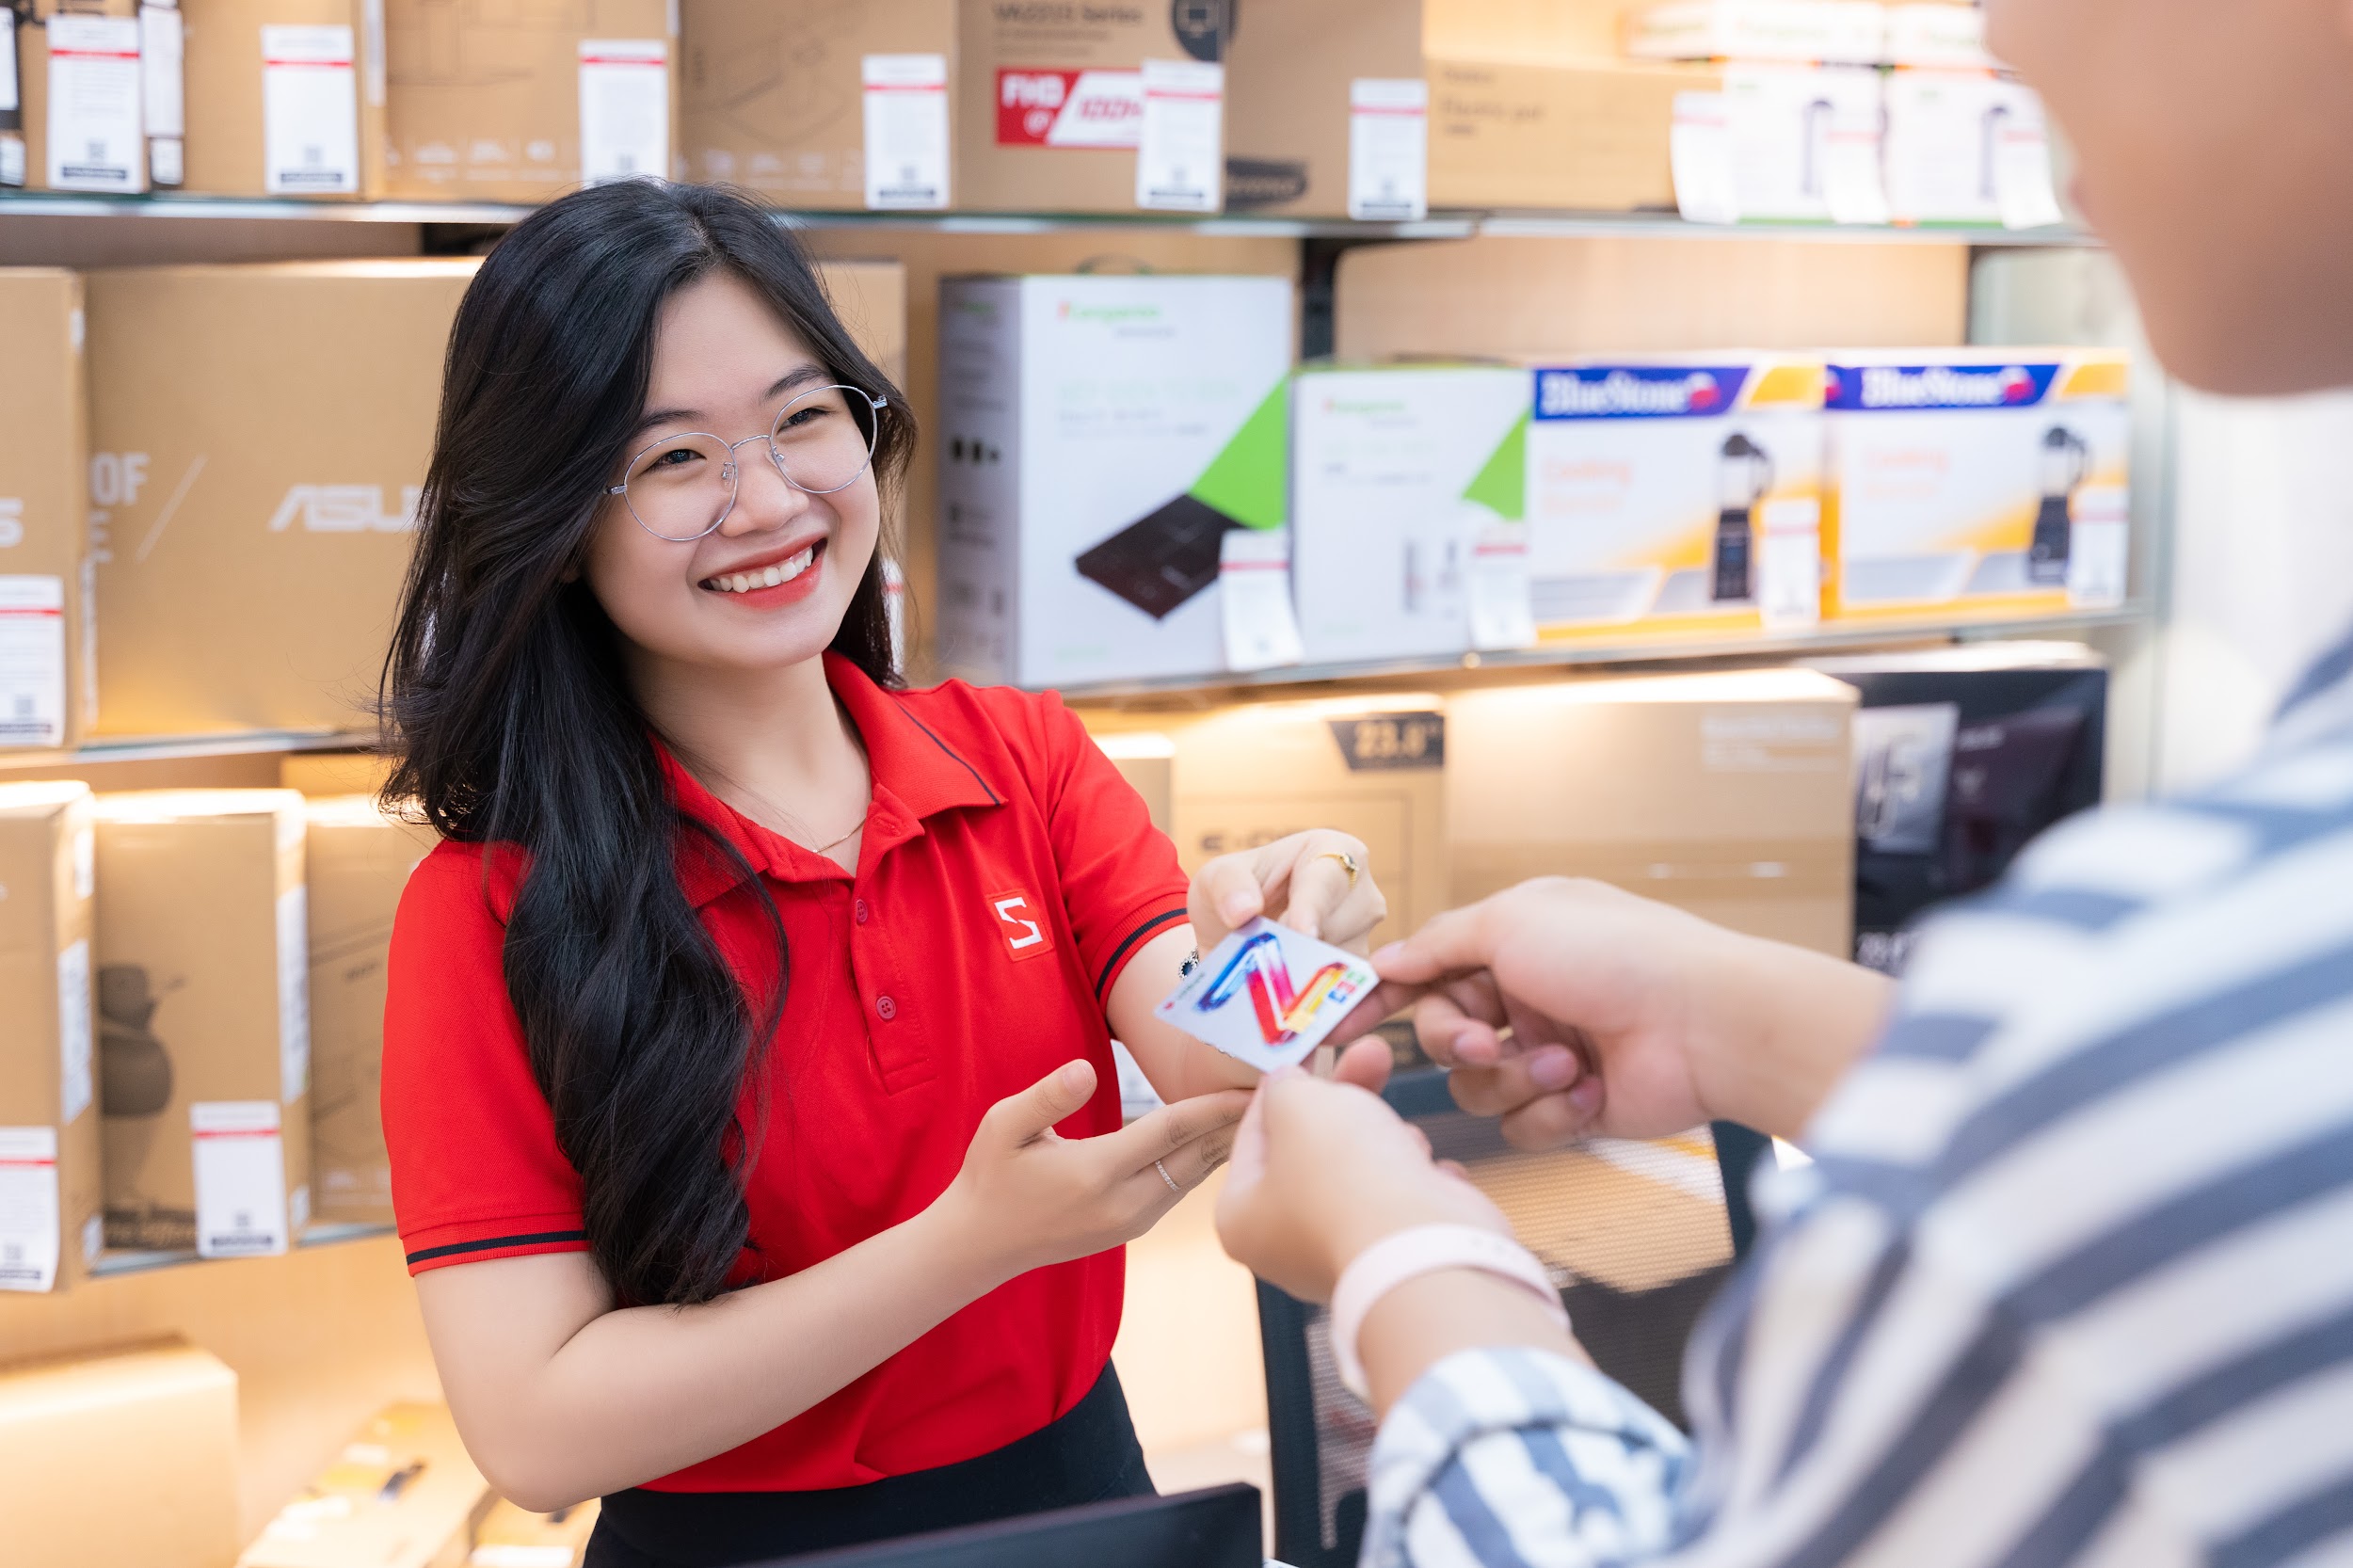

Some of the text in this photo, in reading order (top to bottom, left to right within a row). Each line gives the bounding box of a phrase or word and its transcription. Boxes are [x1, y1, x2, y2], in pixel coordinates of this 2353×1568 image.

[1541, 372, 1689, 416] BlueStone
[1862, 368, 2003, 408] BlueStone
[90, 452, 150, 505] OF
[994, 897, 1044, 950] S
